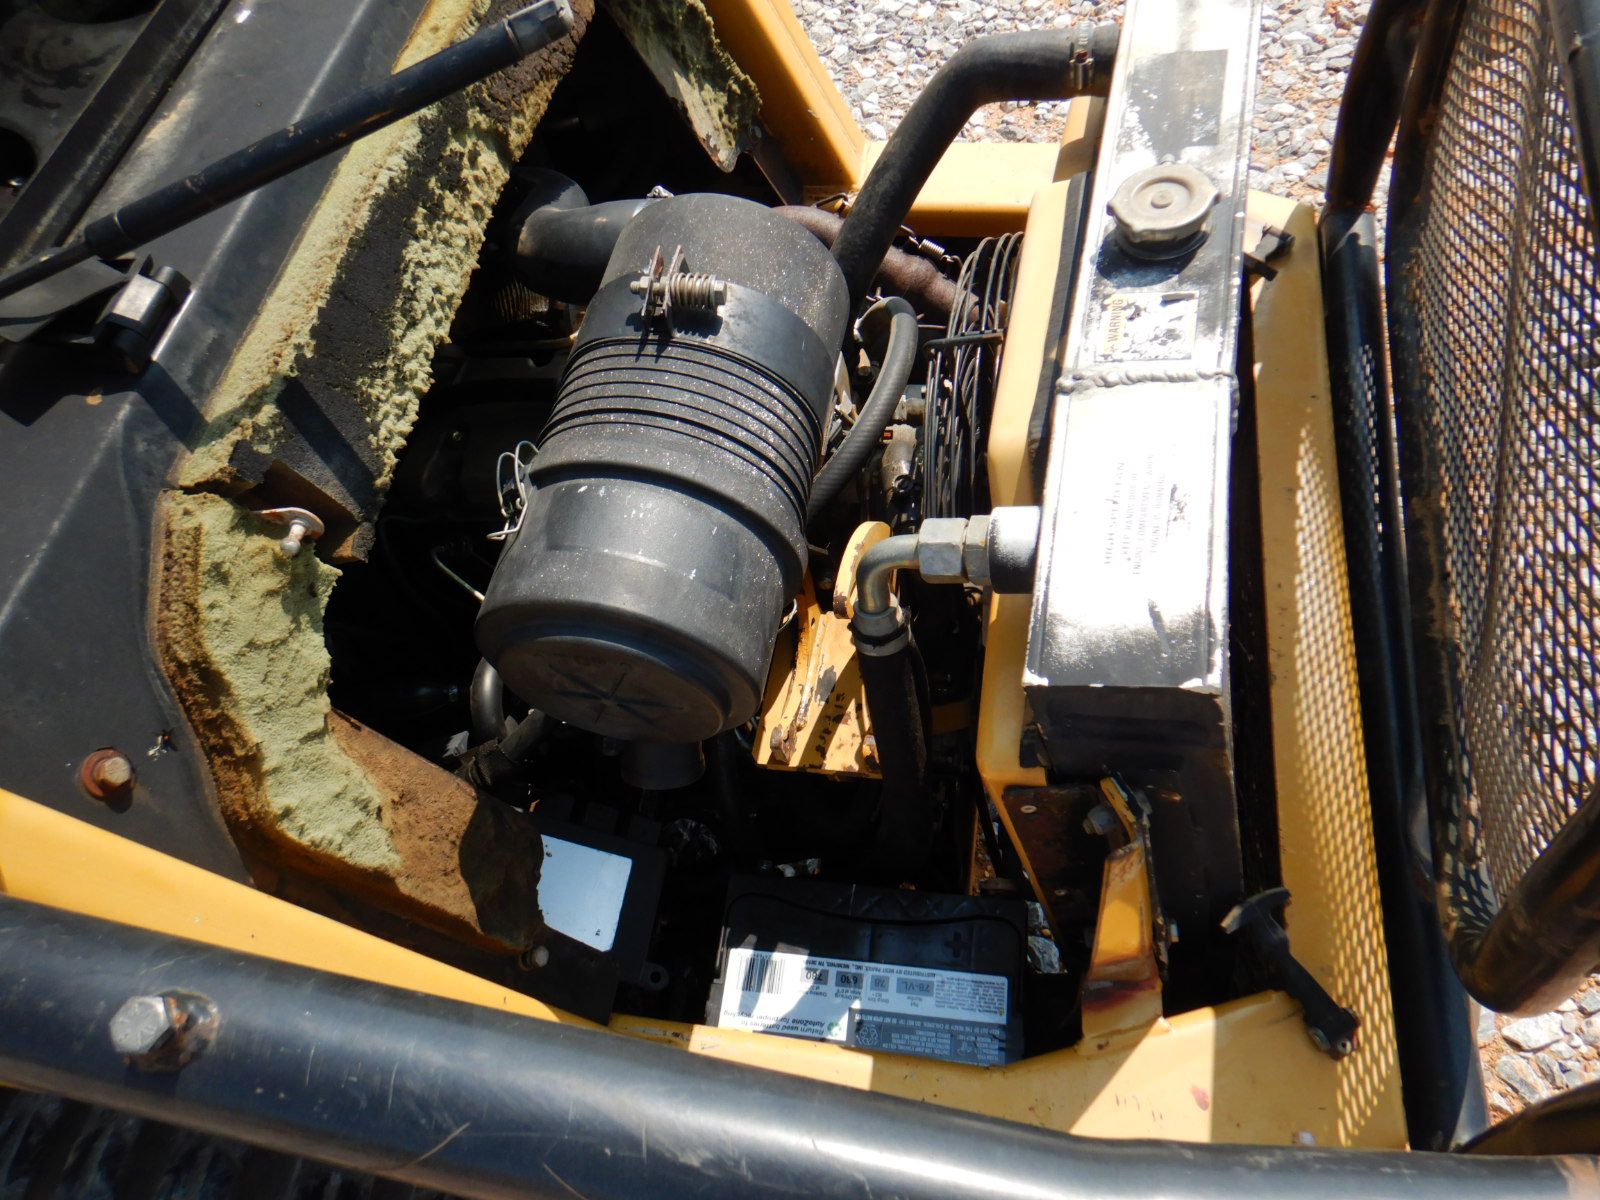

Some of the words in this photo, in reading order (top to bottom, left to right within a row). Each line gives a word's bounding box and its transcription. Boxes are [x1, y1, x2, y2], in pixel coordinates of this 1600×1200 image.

[1107, 299, 1123, 342] WARNING
[873, 978, 885, 988] 78
[900, 980, 930, 993] 78-VL
[723, 1009, 753, 1019] recycling
[755, 1013, 778, 1022] proper
[749, 1020, 779, 1030] batteries
[782, 1024, 798, 1032] used
[791, 1018, 824, 1028] AutoZone
[800, 1026, 823, 1035] Return
